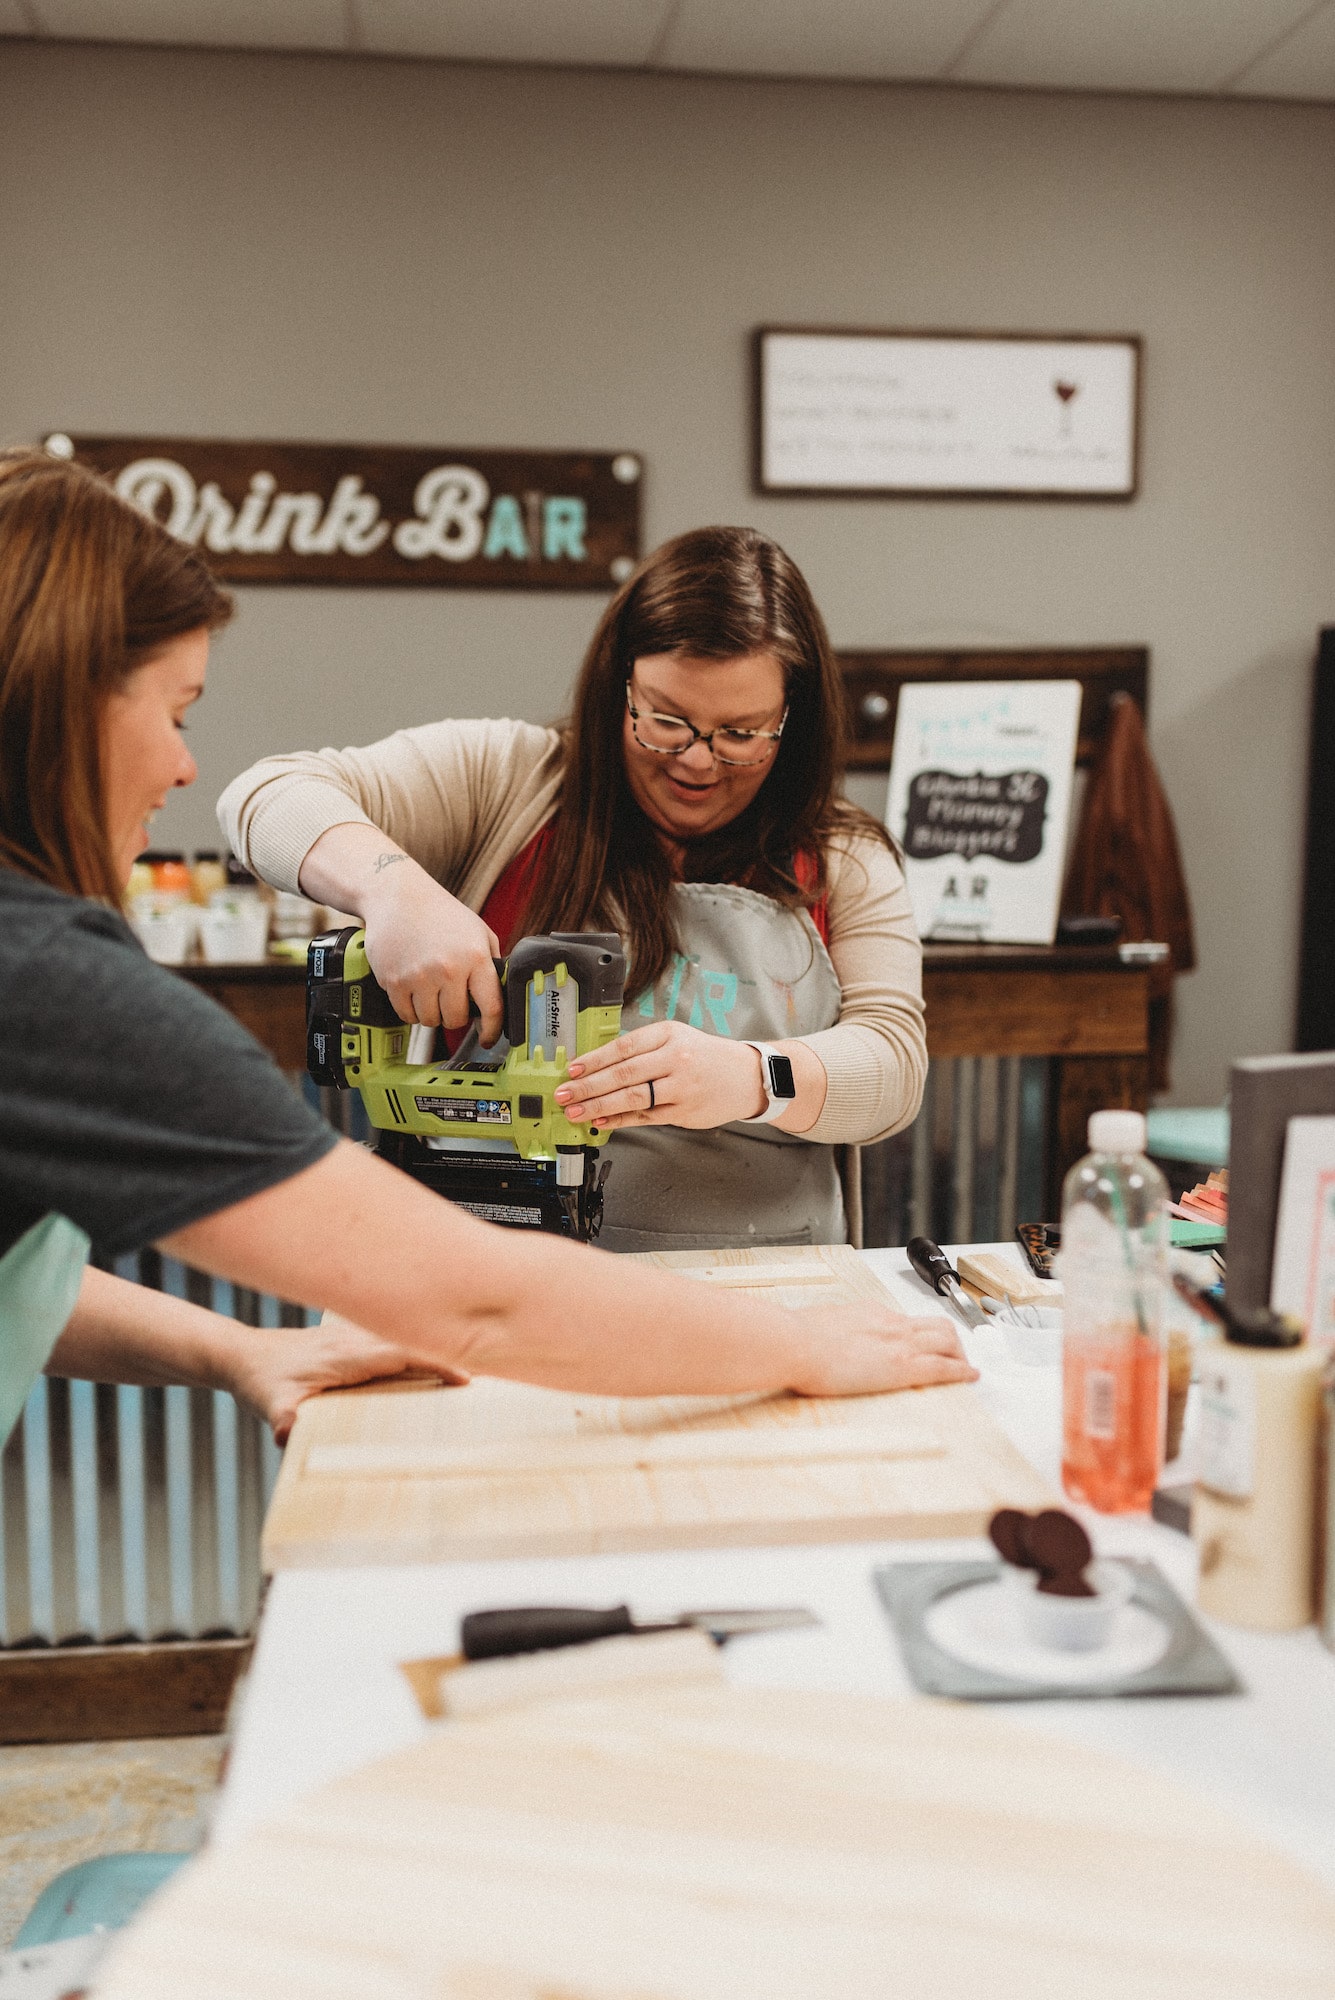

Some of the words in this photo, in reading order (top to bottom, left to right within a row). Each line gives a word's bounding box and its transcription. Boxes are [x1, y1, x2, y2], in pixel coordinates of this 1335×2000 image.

[115, 457, 391, 556] Drink
[393, 464, 588, 563] BAR
[550, 990, 561, 1037] AirStrike
